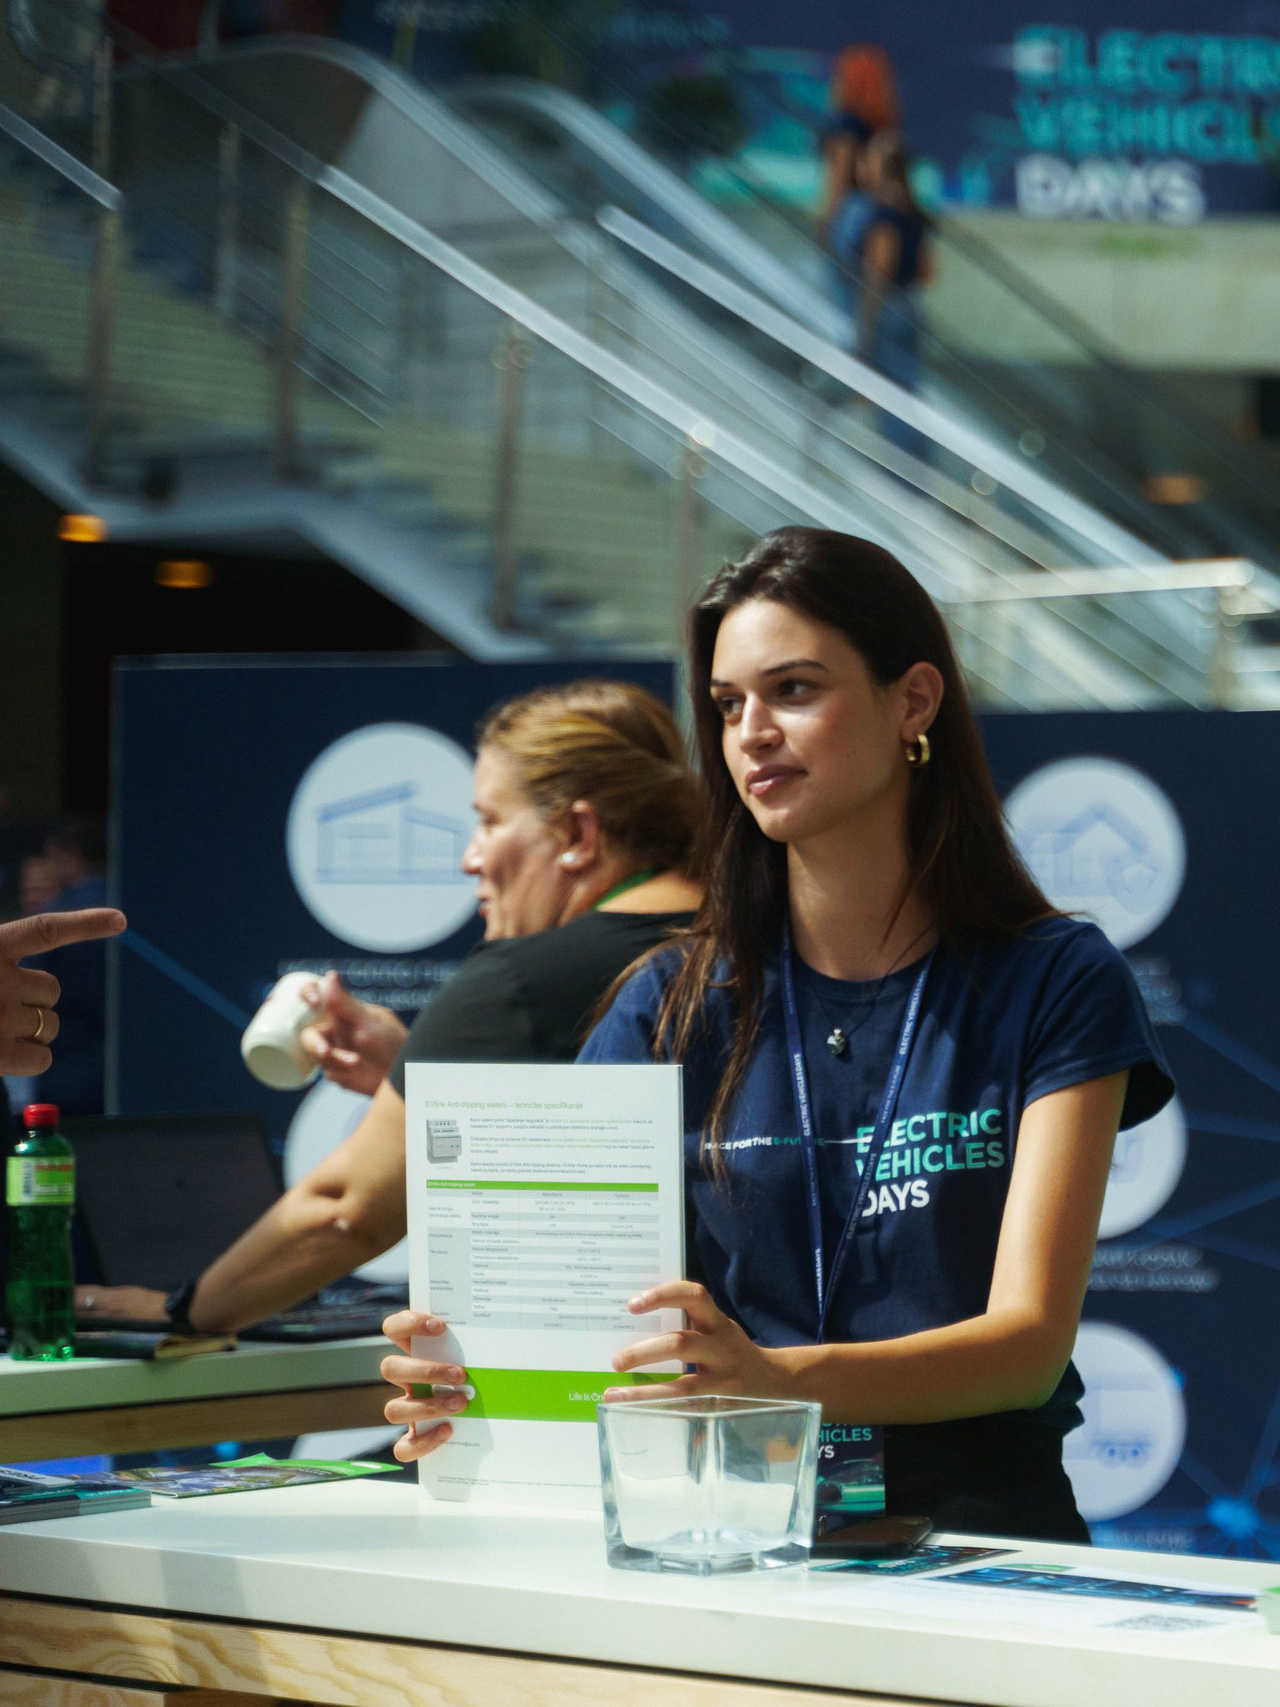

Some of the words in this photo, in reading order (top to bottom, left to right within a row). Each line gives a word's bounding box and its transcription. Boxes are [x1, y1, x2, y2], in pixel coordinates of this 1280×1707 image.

[1015, 155, 1206, 226] DAYS
[898, 1021, 913, 1055] ELECTRIC
[793, 1053, 802, 1072] DAYS
[795, 1071, 806, 1103] VEHICLES
[799, 1103, 811, 1136] ELECTRIC
[857, 1108, 1001, 1154] EECTRIC
[753, 1137, 773, 1148] THE
[865, 1152, 877, 1171] DAYS
[568, 1392, 582, 1402] Life
[818, 1427, 873, 1443] HICLES
[818, 1444, 835, 1459] YS
